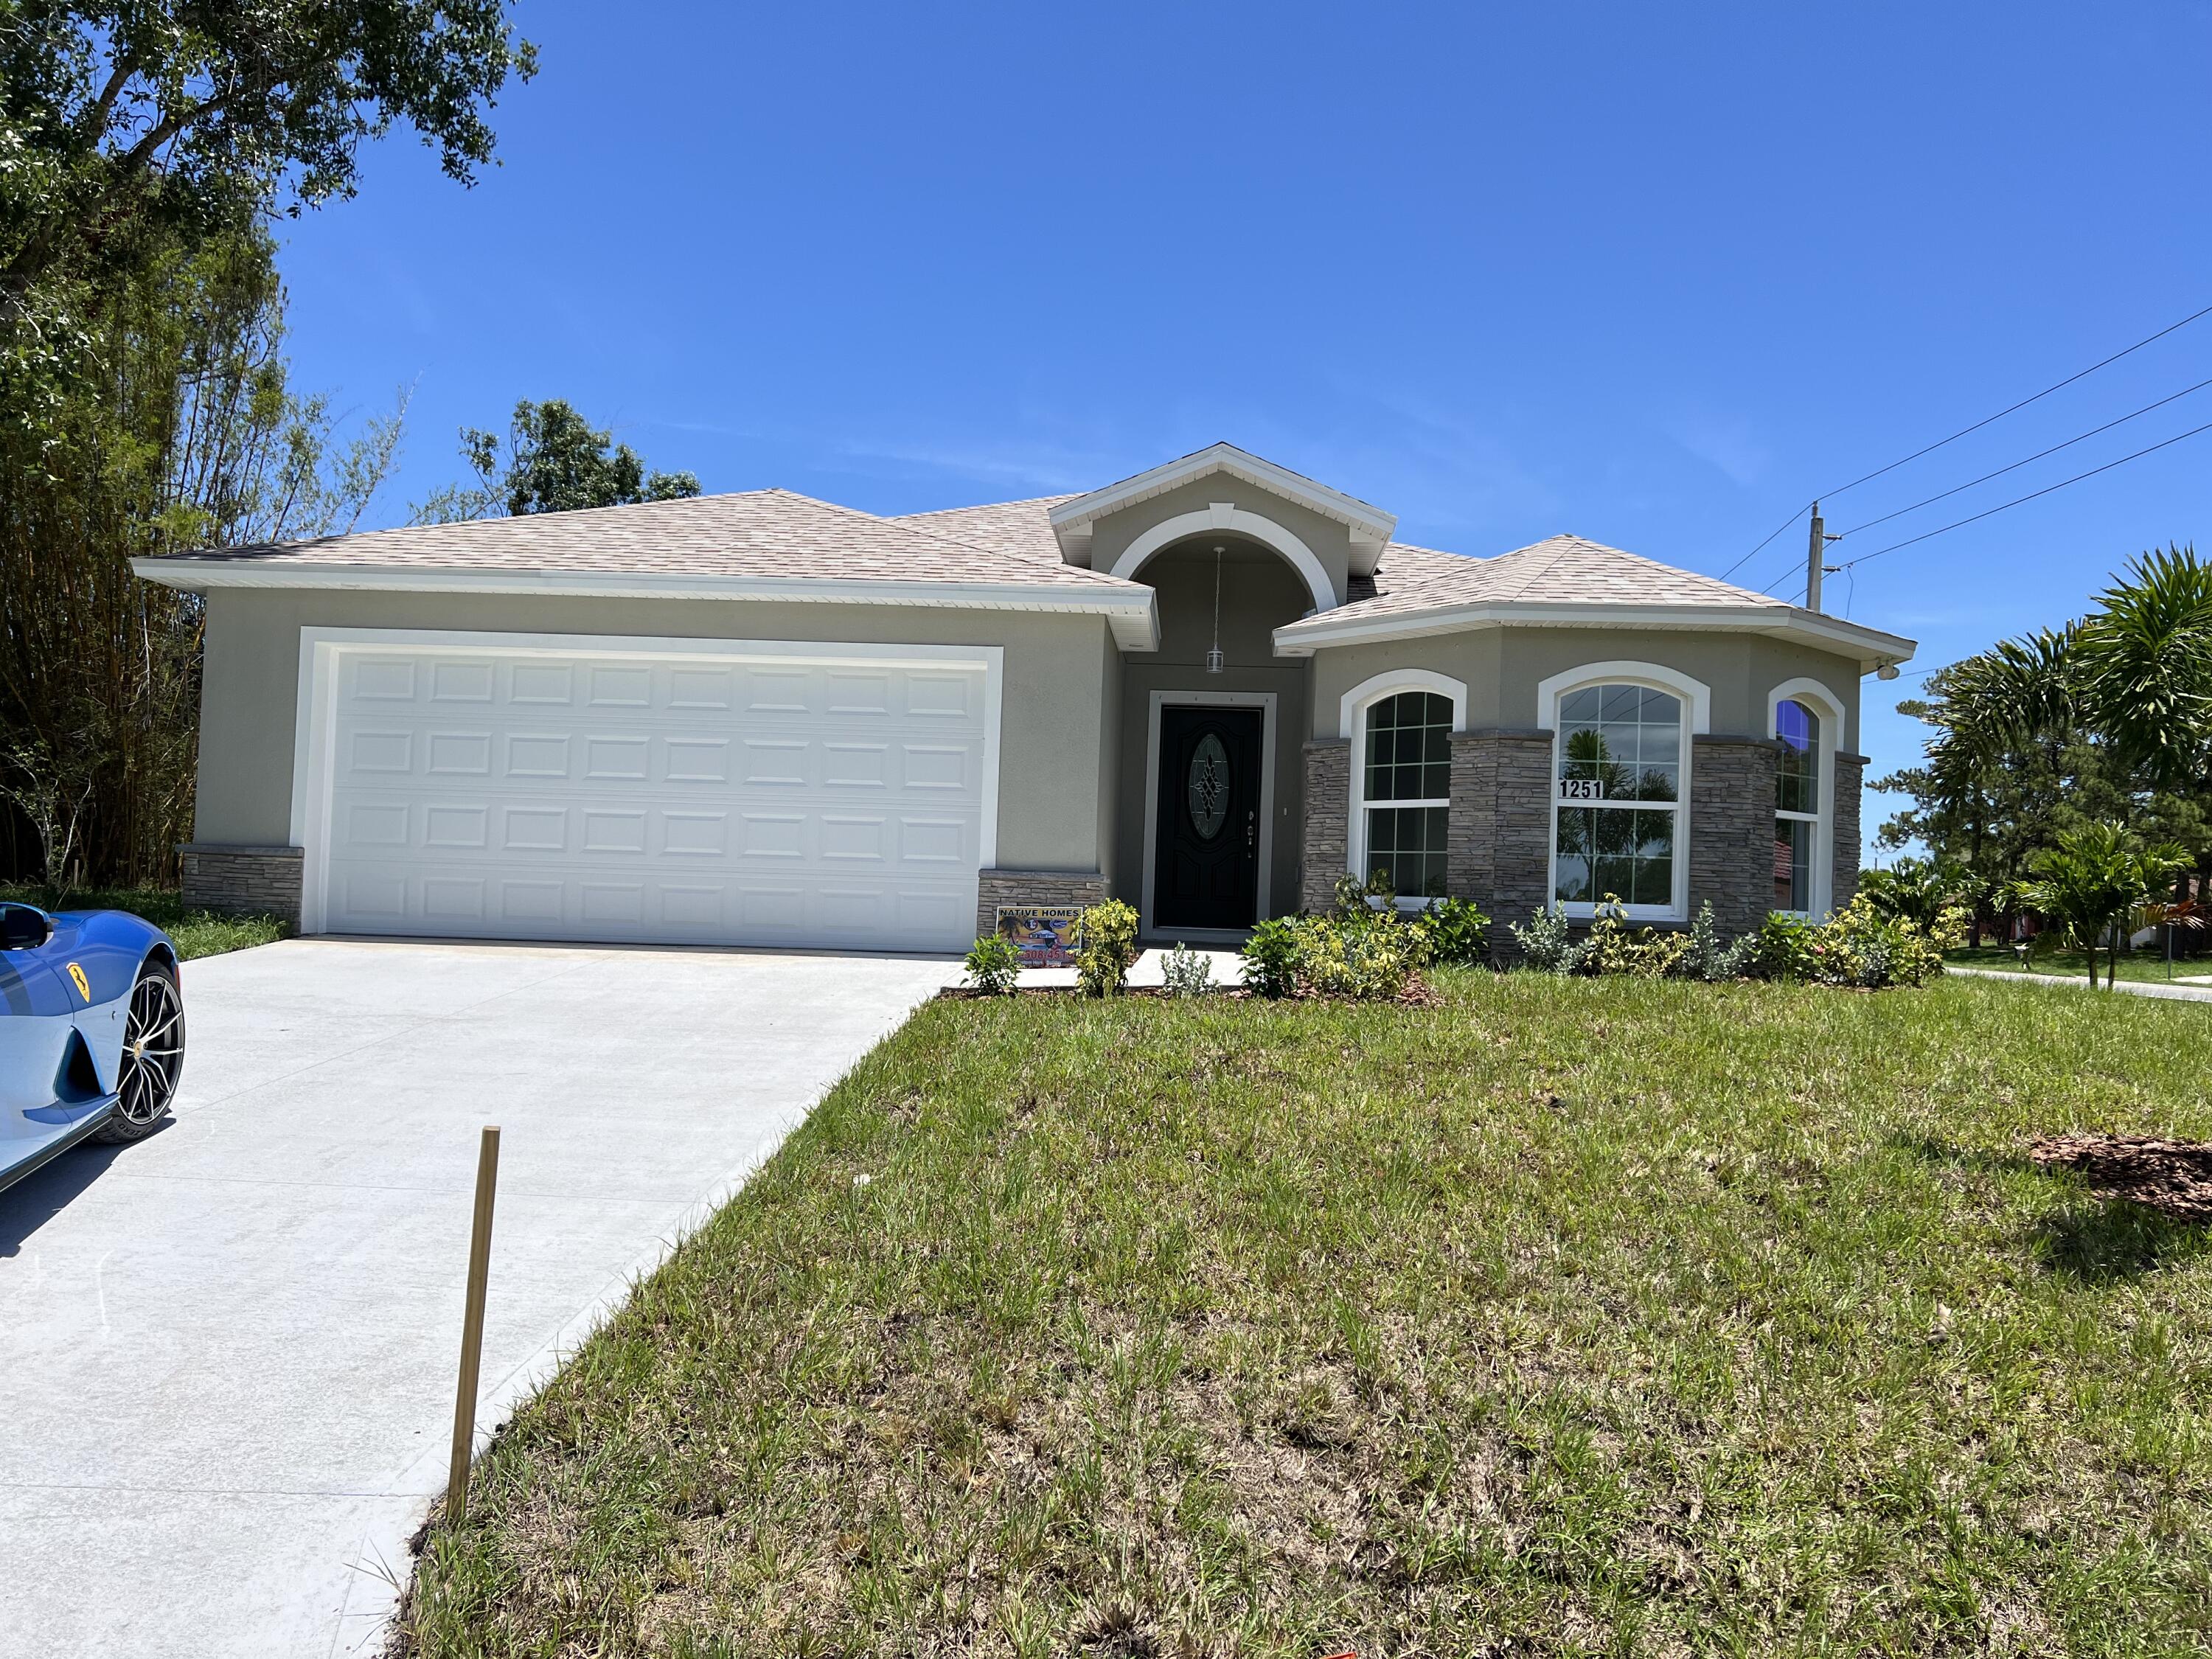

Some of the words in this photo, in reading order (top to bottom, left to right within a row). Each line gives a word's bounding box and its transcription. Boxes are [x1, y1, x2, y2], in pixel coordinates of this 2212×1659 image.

[1559, 780, 1601, 799] 1251
[1042, 909, 1079, 917] HOMES
[118, 1123, 142, 1135] ZERO
